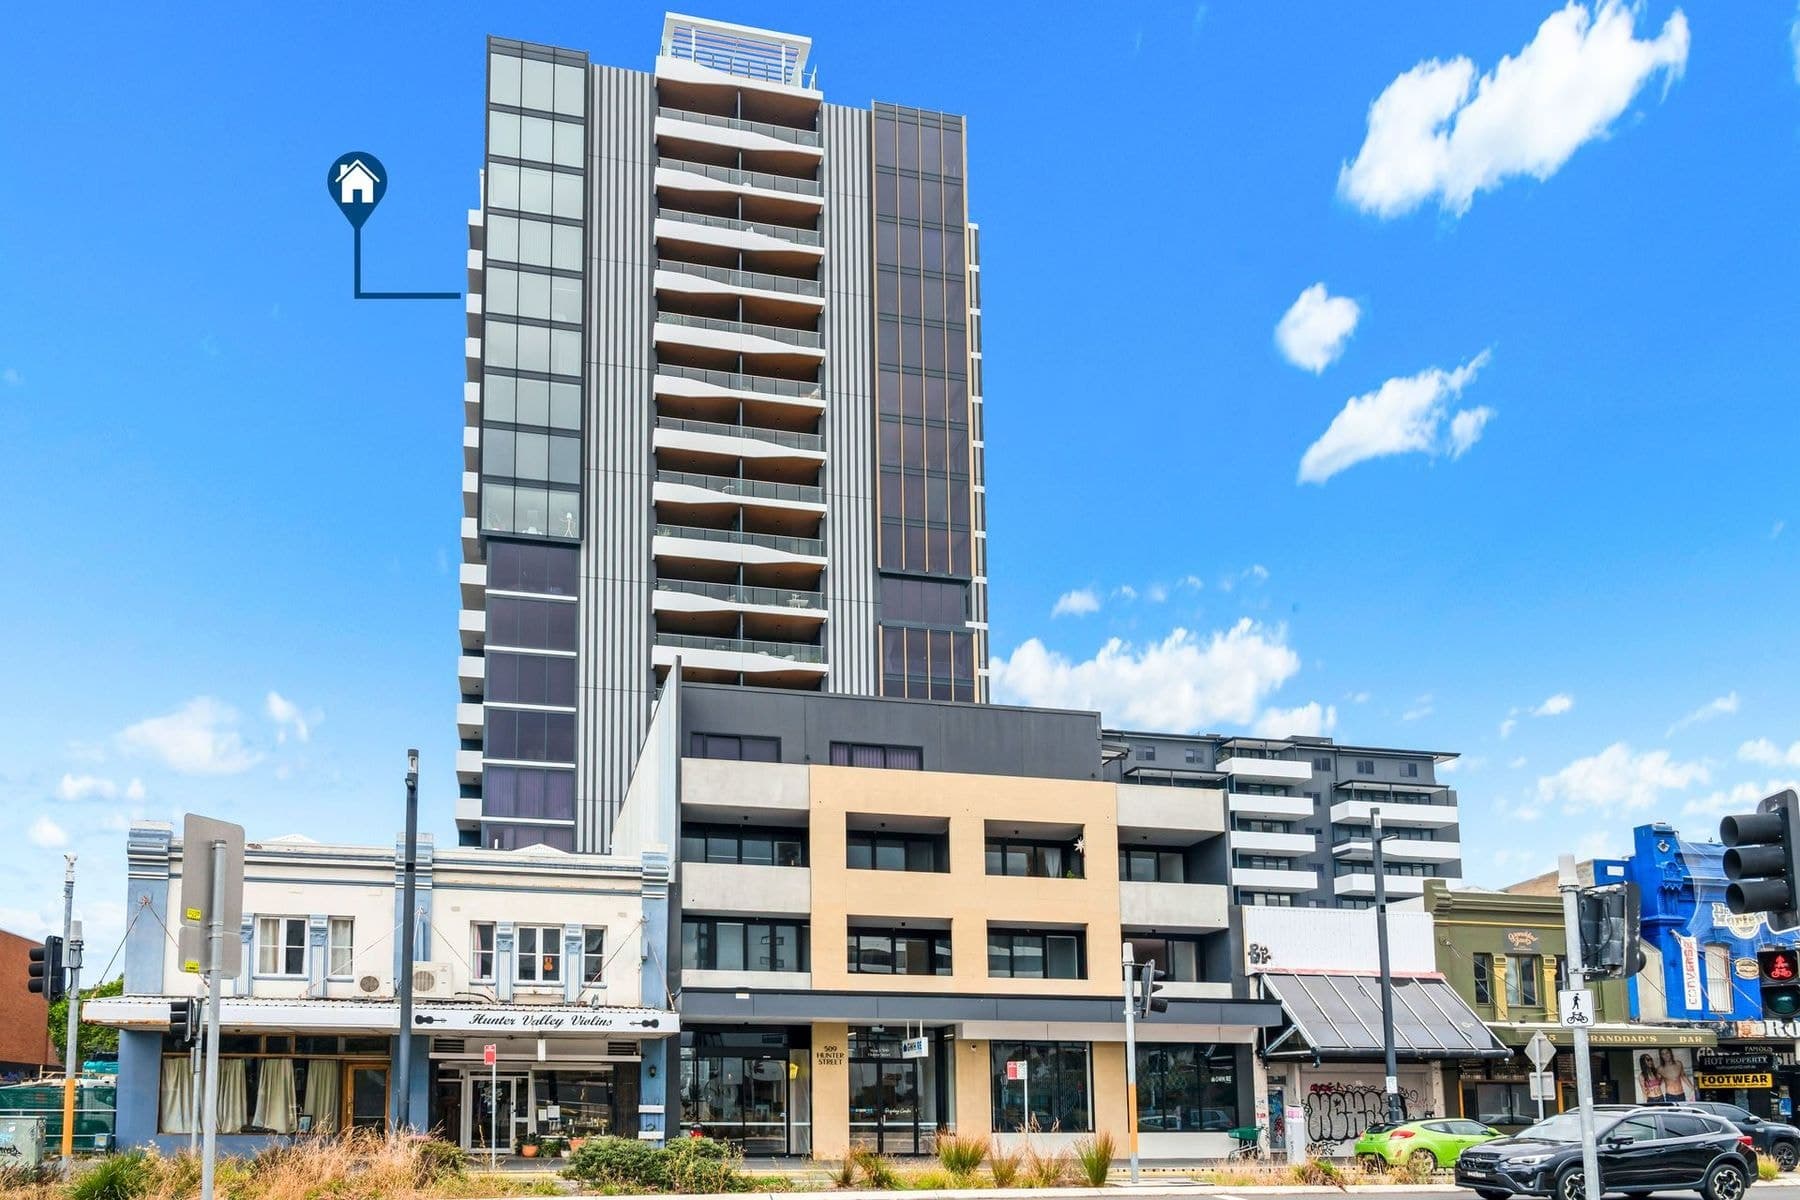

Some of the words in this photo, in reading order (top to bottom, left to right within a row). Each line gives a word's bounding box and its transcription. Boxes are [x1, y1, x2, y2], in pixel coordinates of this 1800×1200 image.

[469, 1013, 515, 1026] Hunter
[522, 1014, 564, 1028] Valley
[571, 1015, 612, 1027] Violins
[1588, 1034, 1657, 1043] RANDDAD'S
[1679, 1036, 1703, 1044] BAR
[1704, 1057, 1724, 1066] HOT
[1725, 1056, 1769, 1065] PROPERTY
[1702, 1075, 1769, 1084] FOOTWEAR
